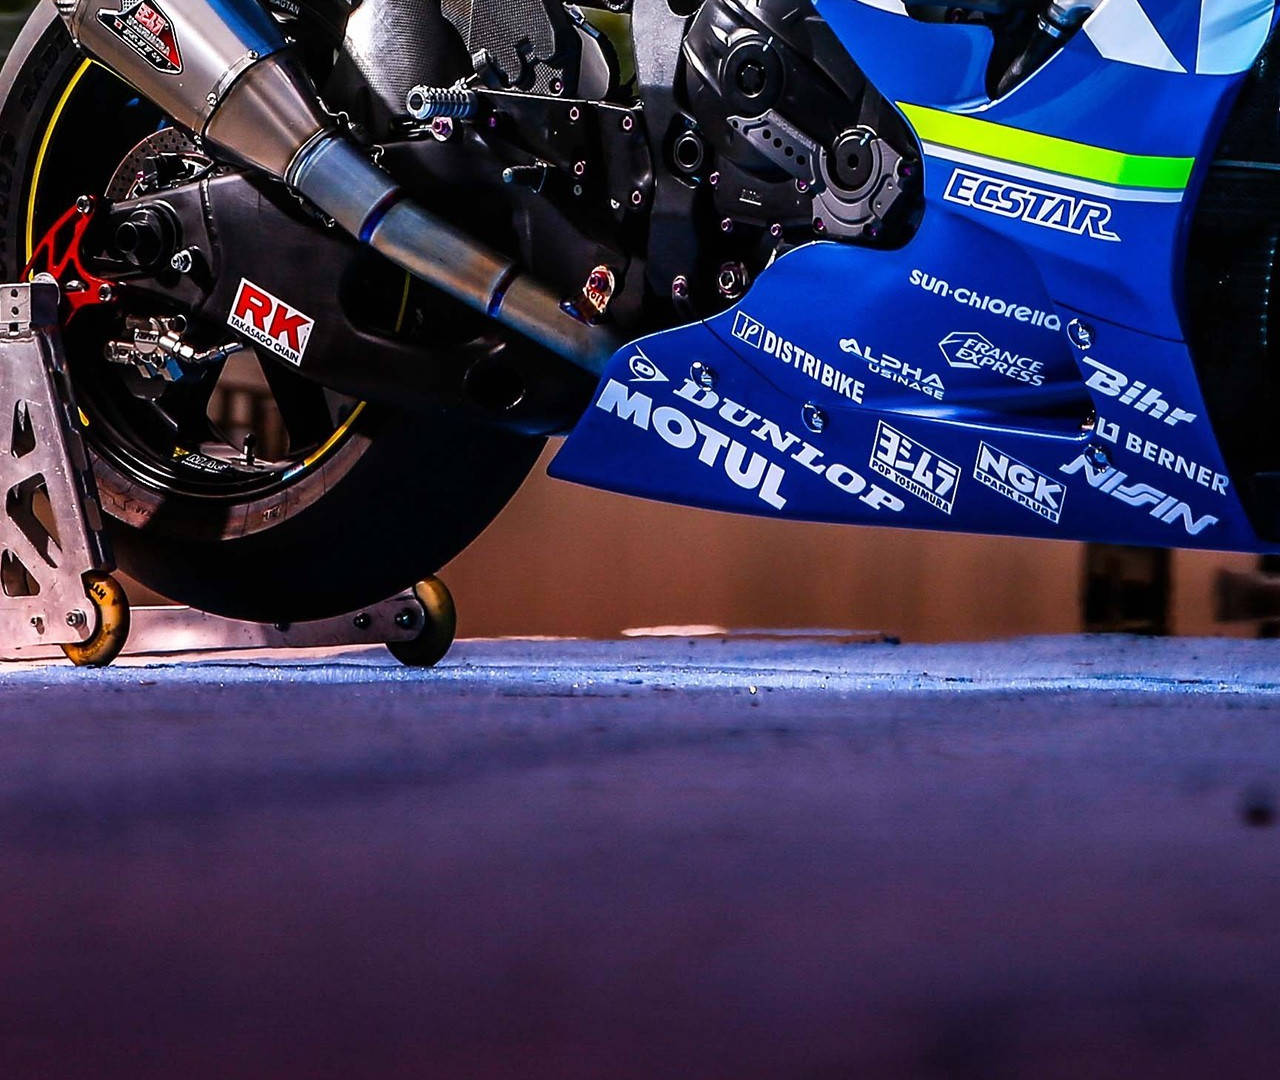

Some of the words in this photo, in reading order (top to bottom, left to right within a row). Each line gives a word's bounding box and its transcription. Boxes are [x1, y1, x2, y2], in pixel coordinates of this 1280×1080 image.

[943, 167, 1122, 242] ECSTAR
[230, 315, 273, 347] TAKASAGO
[273, 342, 300, 364] CHAIN
[233, 282, 312, 355] RK
[839, 337, 945, 390] ALPHA
[868, 363, 945, 401] USINAGE
[955, 347, 1045, 387] EXPRESS
[963, 337, 1044, 373] FRANCE
[1082, 355, 1198, 427] Bihr
[596, 378, 789, 510] MOTUL
[673, 377, 905, 512] DUNLOP
[1125, 432, 1230, 496] BERNER
[872, 460, 892, 476] POP
[894, 471, 951, 514] YOSHIMURA
[974, 471, 1015, 499] SPARK
[1017, 494, 1059, 523] PLUGS
[978, 444, 1063, 510] NGK
